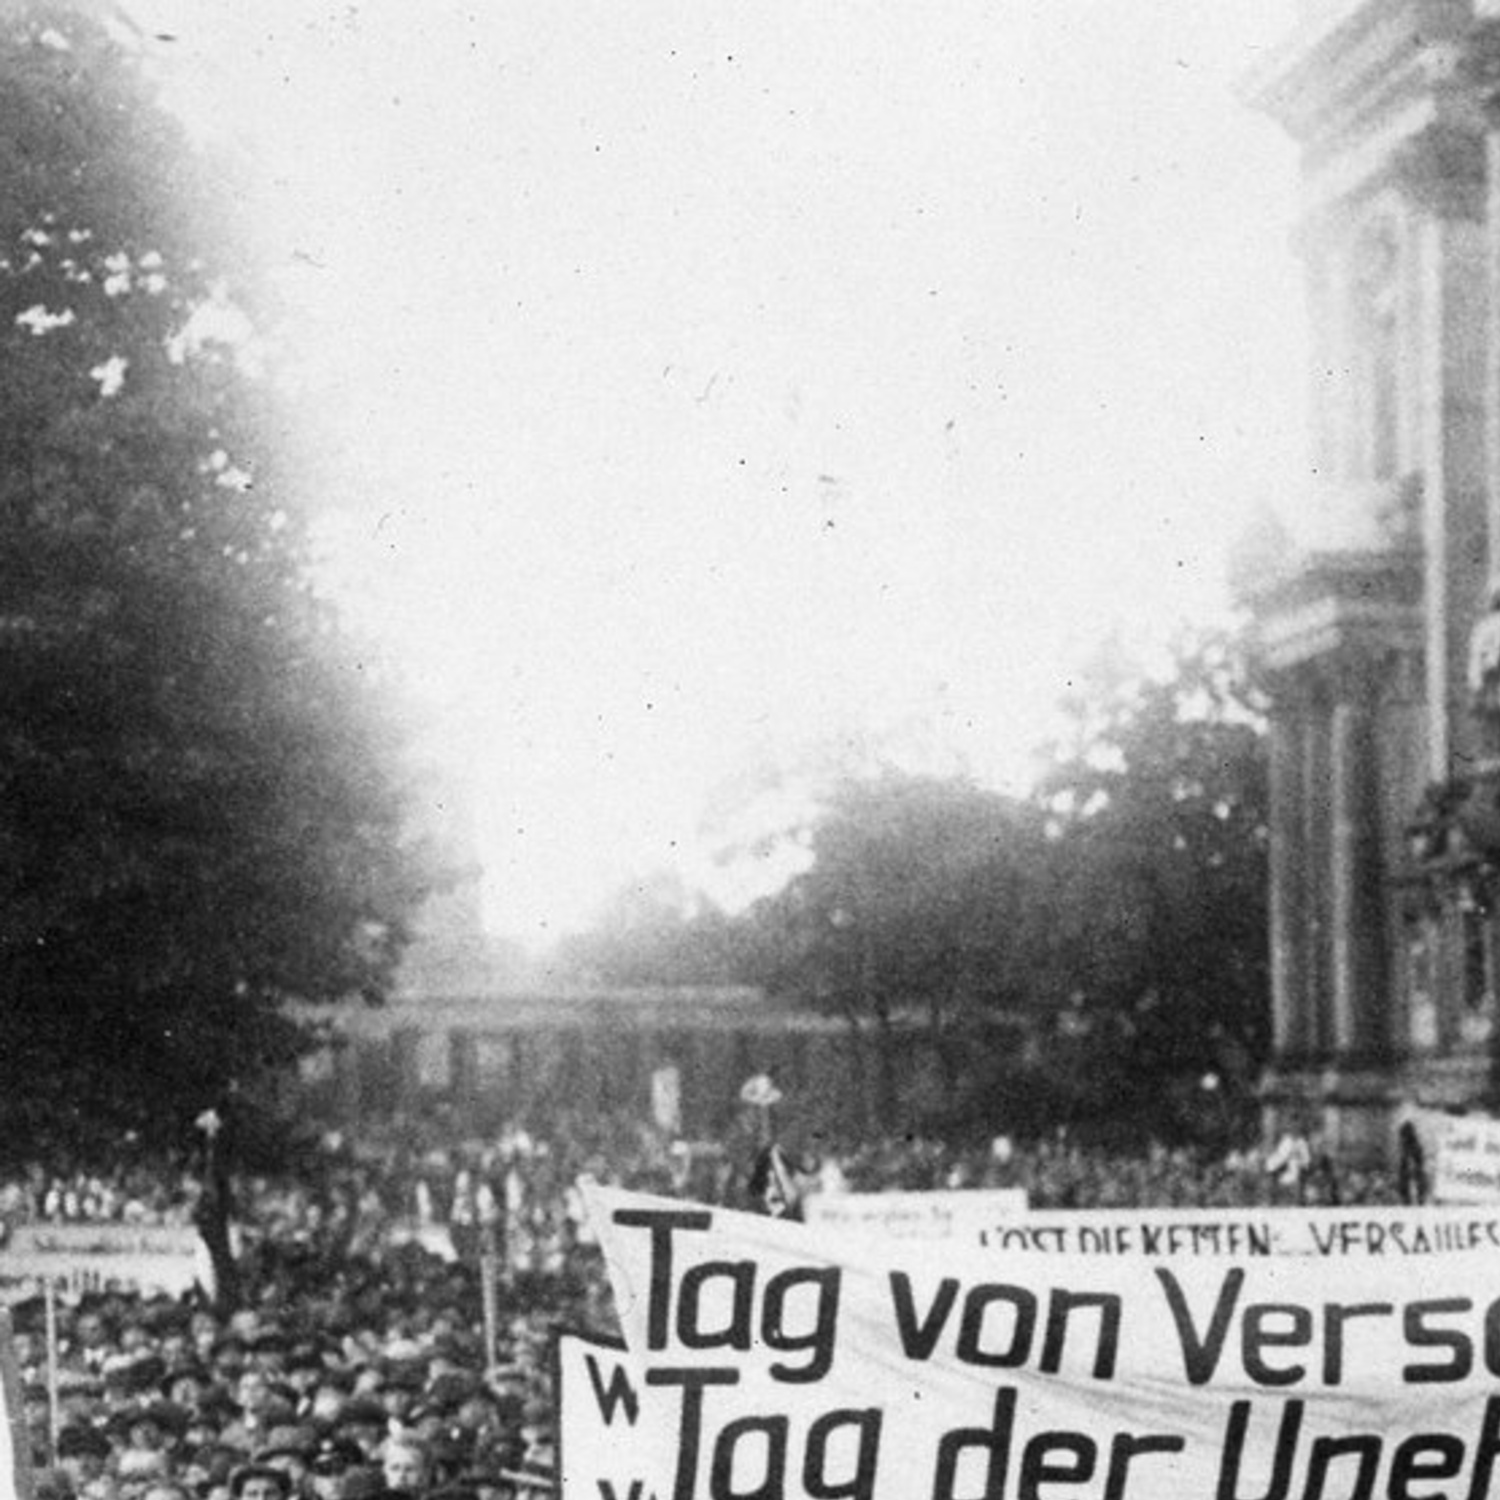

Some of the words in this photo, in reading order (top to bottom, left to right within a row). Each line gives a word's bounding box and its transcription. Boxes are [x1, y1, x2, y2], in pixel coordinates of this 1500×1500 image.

[1140, 1223, 1272, 1257] KETTEN
[613, 1209, 841, 1384] Tag
[889, 1272, 1121, 1381] von
